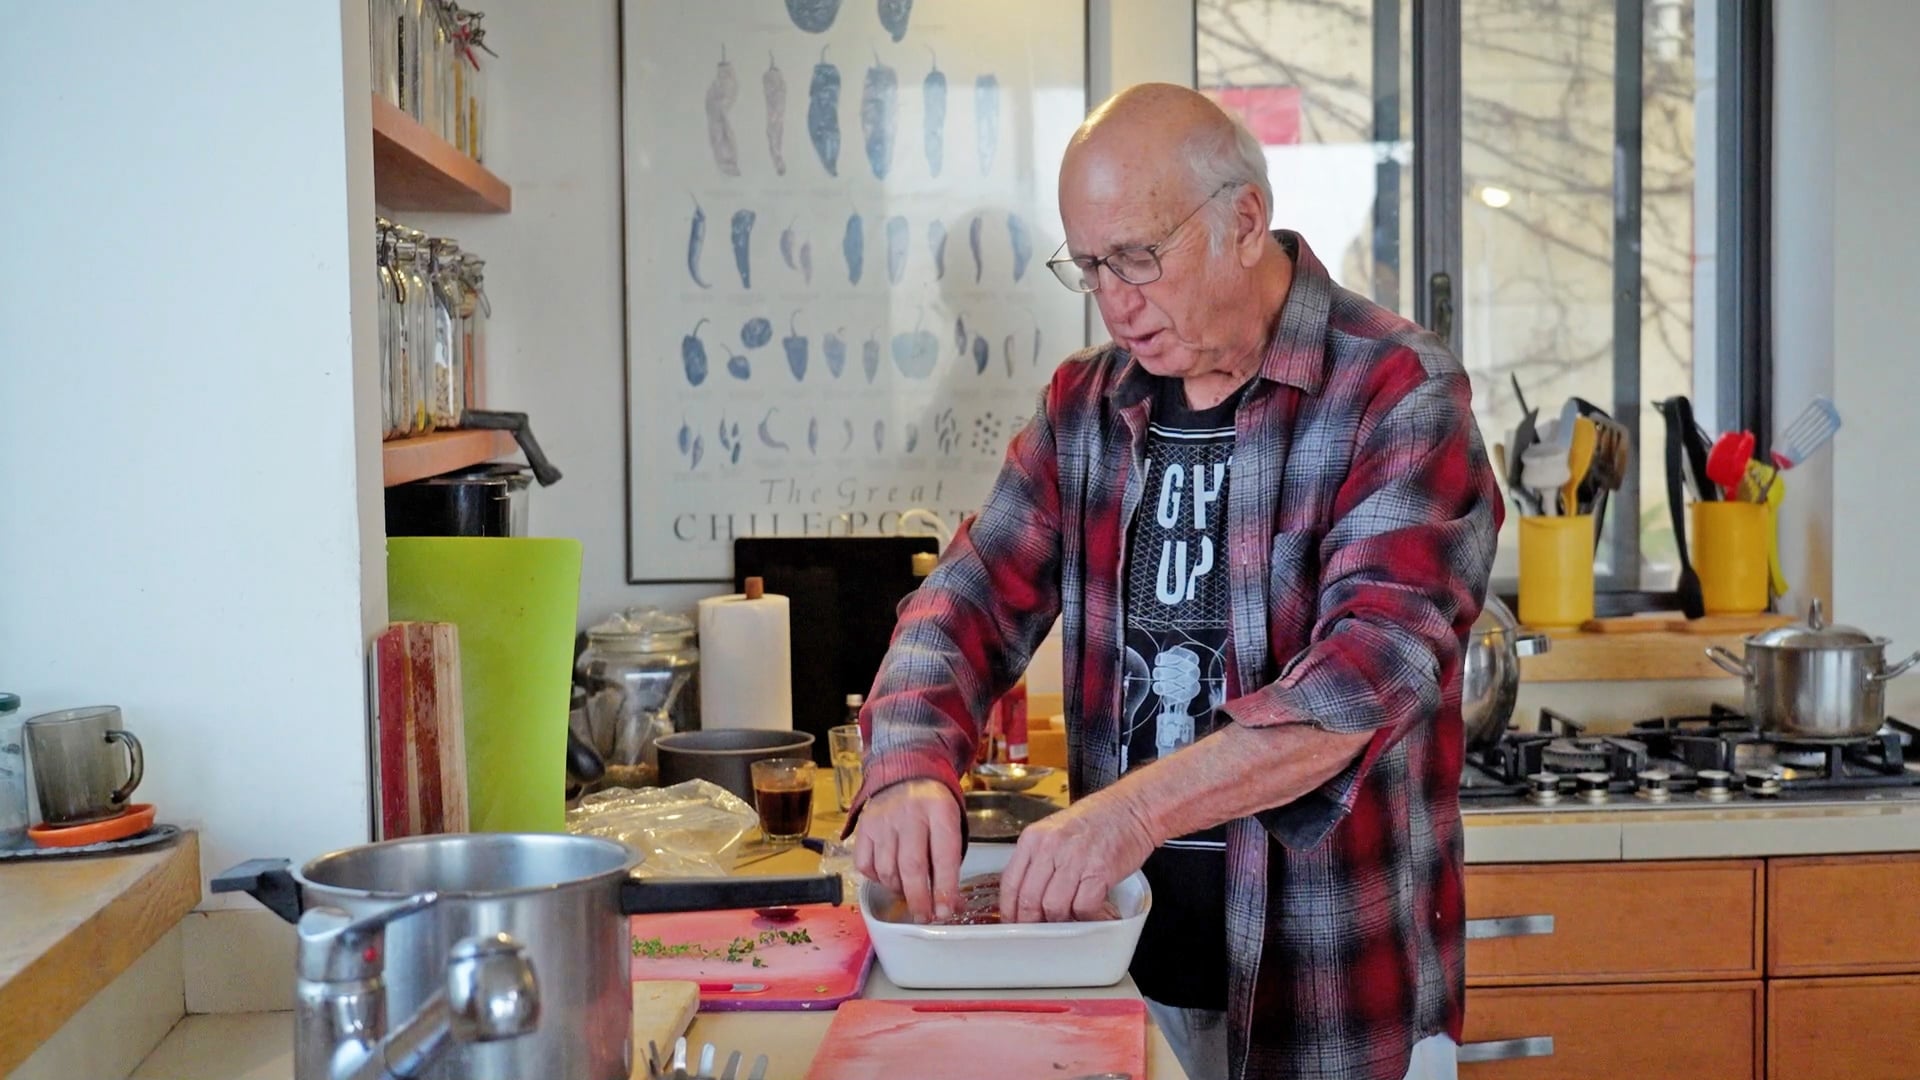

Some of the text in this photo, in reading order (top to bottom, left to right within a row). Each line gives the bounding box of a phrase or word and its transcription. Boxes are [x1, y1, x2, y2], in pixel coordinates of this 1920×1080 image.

[759, 477, 944, 510] The Great
[1155, 536, 1214, 605] UP
